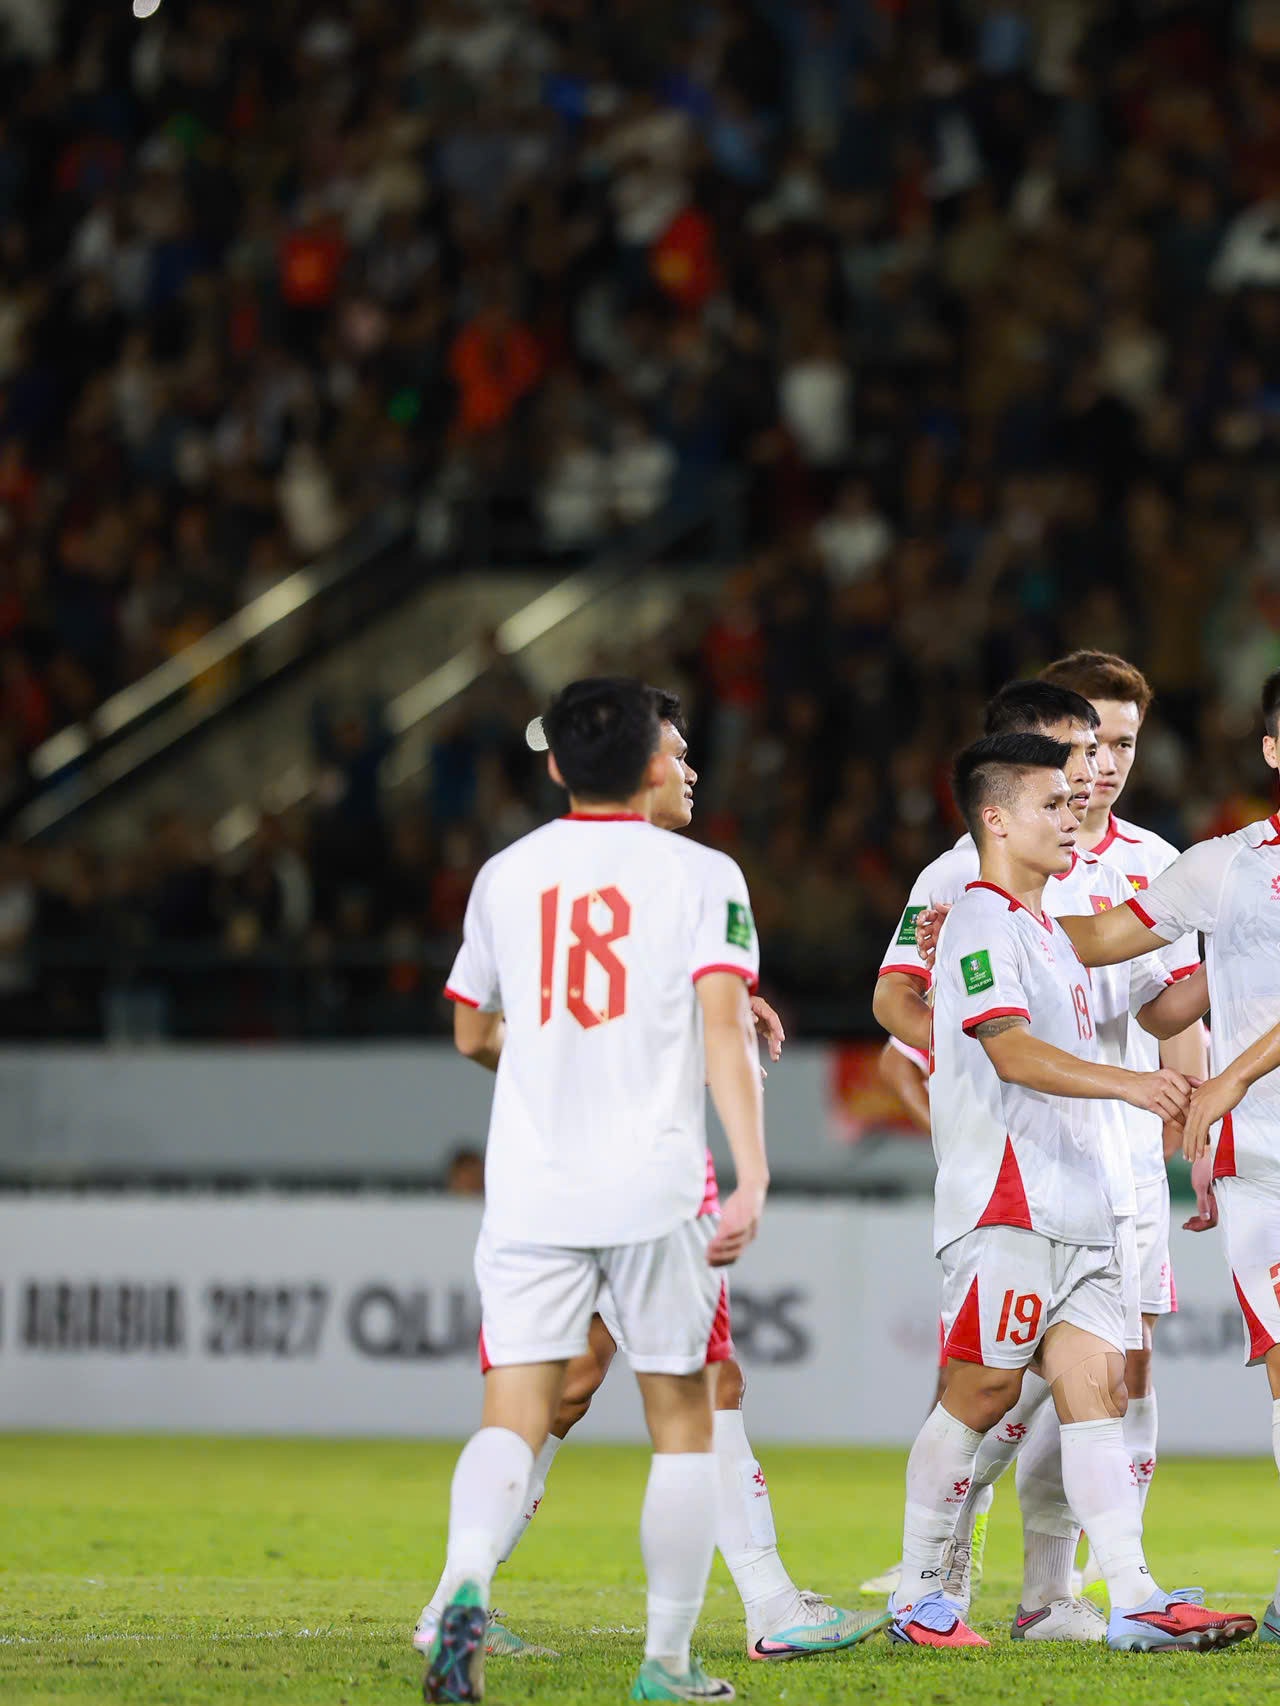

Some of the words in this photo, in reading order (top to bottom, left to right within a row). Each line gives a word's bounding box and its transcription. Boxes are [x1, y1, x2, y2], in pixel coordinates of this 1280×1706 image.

[540, 885, 631, 1029] 18
[1069, 984, 1093, 1040] 19
[205, 1281, 332, 1356] 2027
[996, 1289, 1042, 1345] 19
